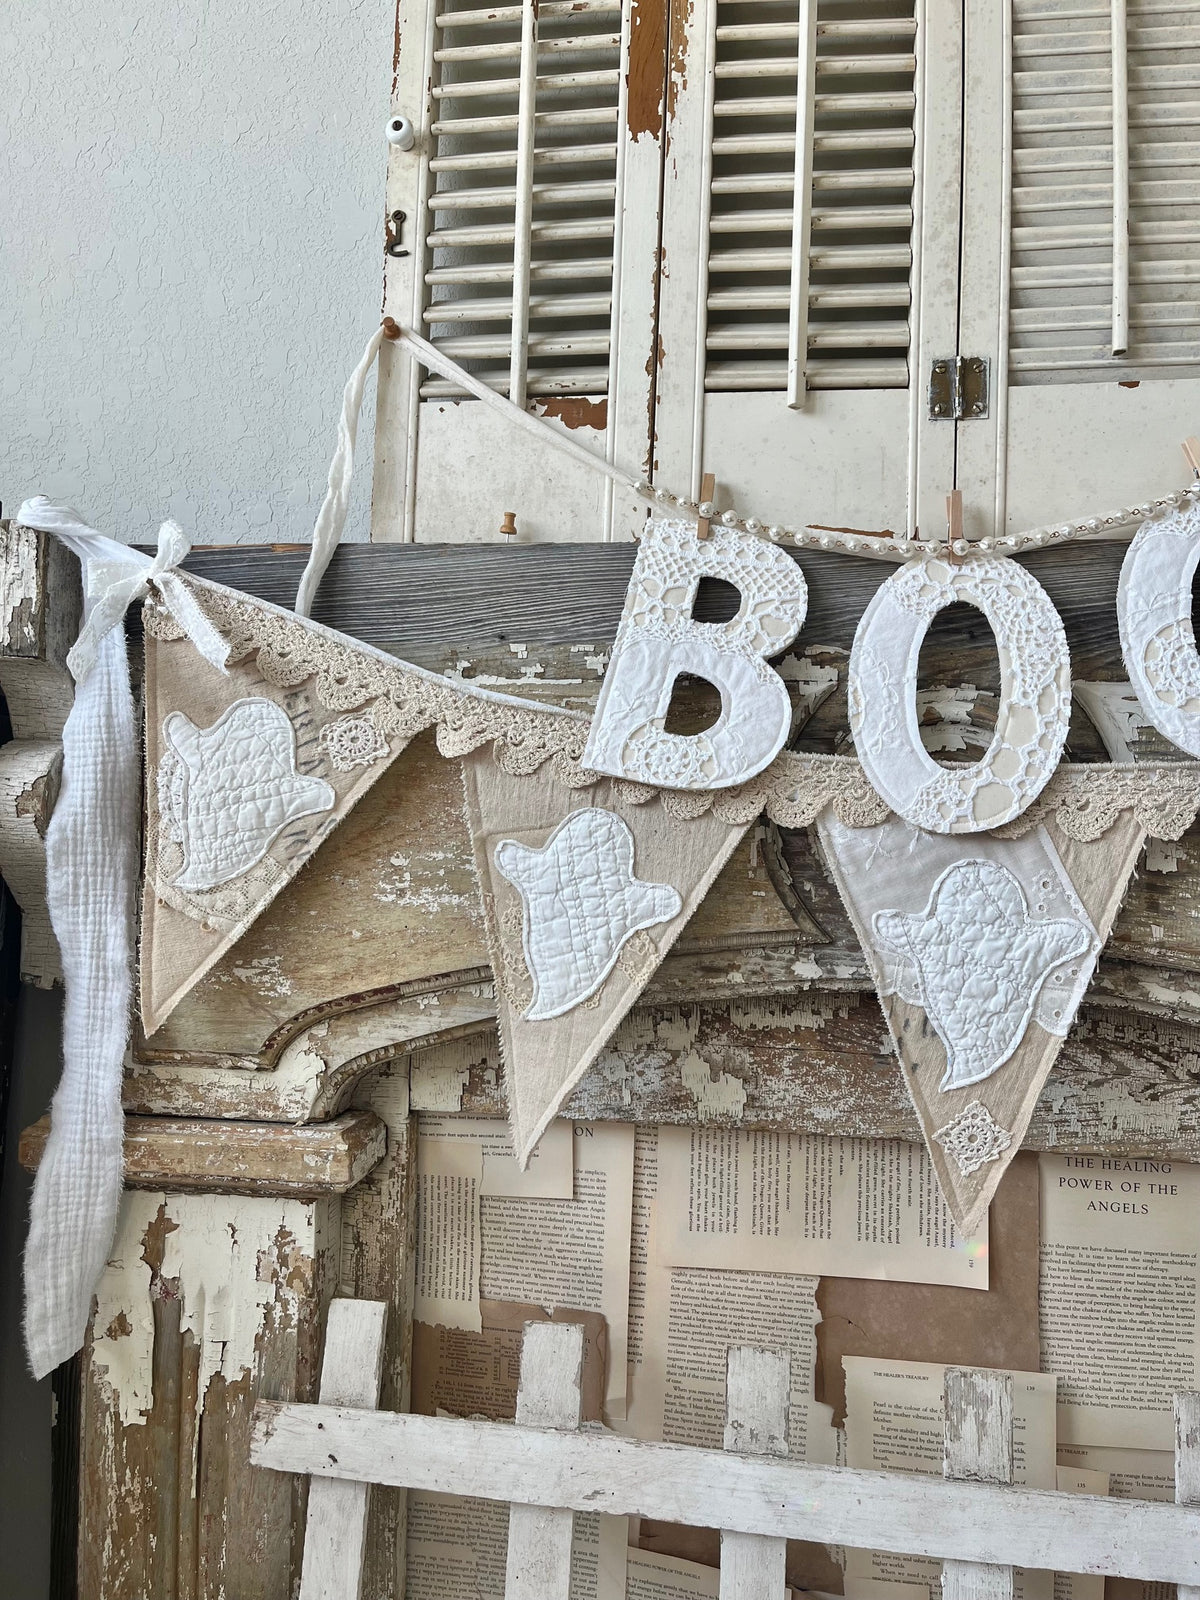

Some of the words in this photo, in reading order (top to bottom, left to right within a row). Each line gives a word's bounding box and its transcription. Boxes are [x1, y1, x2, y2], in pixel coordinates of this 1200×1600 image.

[1064, 1156, 1094, 1168] THE
[1102, 1160, 1172, 1174] HEALING
[1059, 1177, 1113, 1191] POWER
[1120, 1181, 1141, 1193] OF
[1148, 1183, 1178, 1195] THE
[1087, 1201, 1149, 1214] ANGELS
